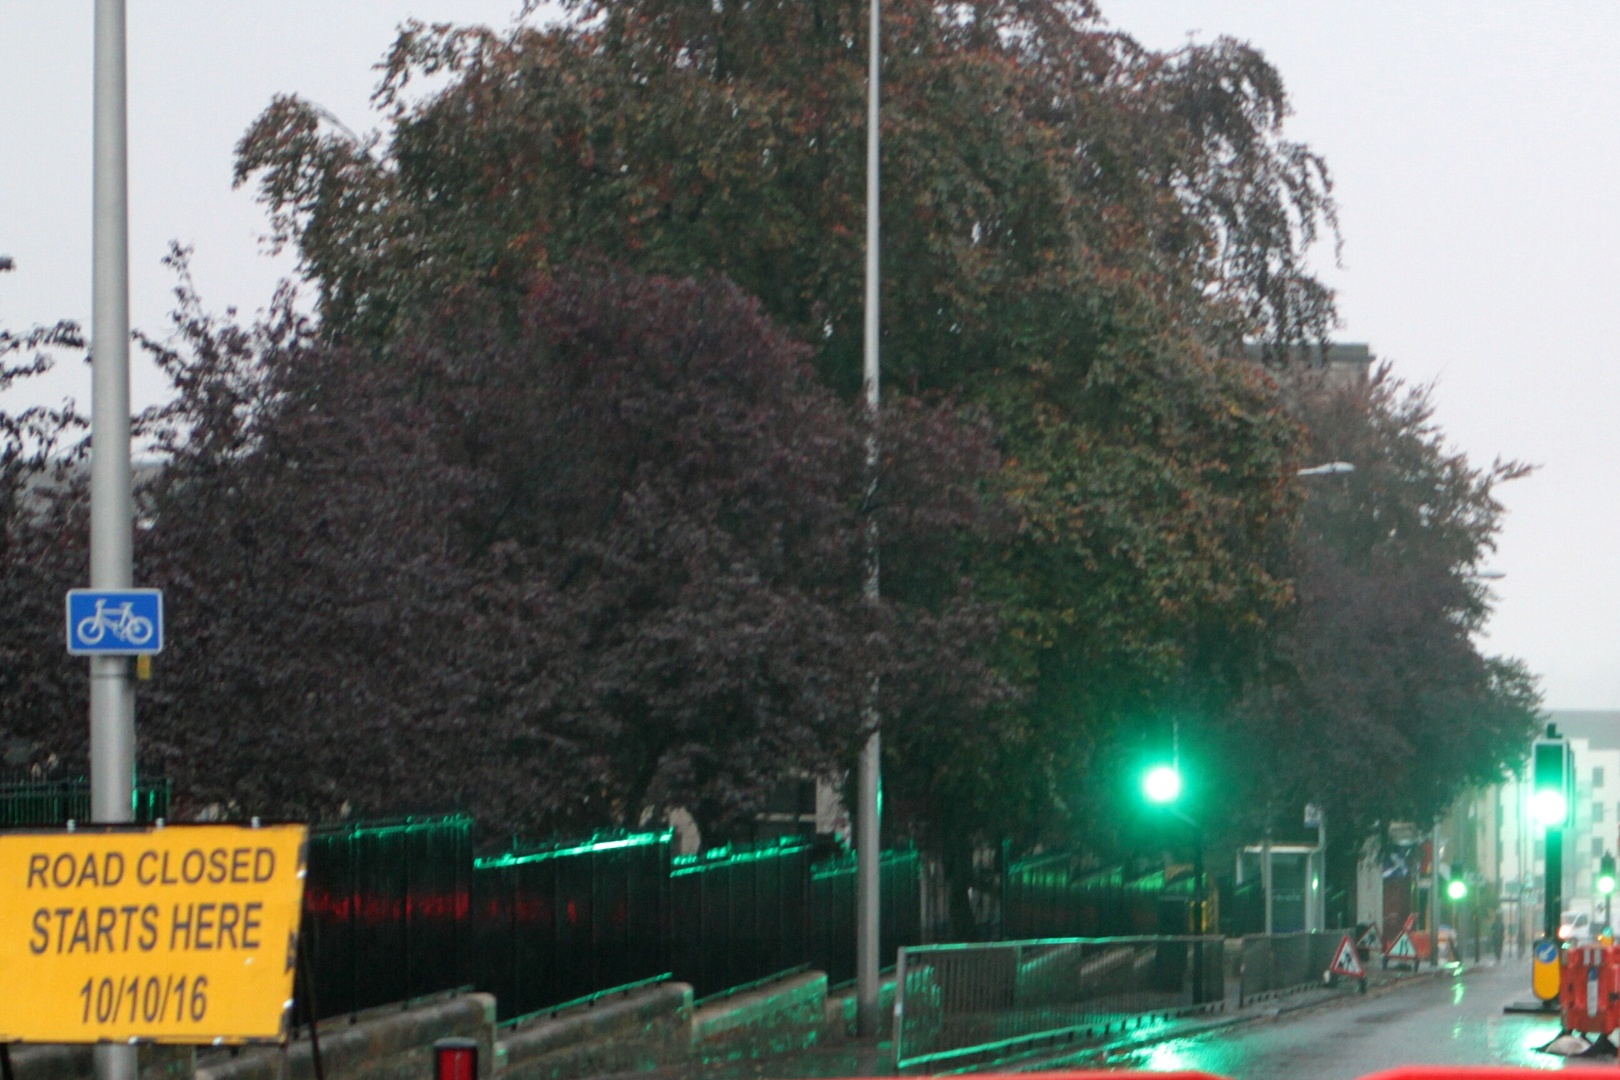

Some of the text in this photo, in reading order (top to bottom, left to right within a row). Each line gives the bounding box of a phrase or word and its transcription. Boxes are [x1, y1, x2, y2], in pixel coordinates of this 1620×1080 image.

[27, 848, 275, 888] ROAD CLOSED
[30, 902, 263, 955] STARTS HERE
[80, 975, 208, 1024] 10/10/16
